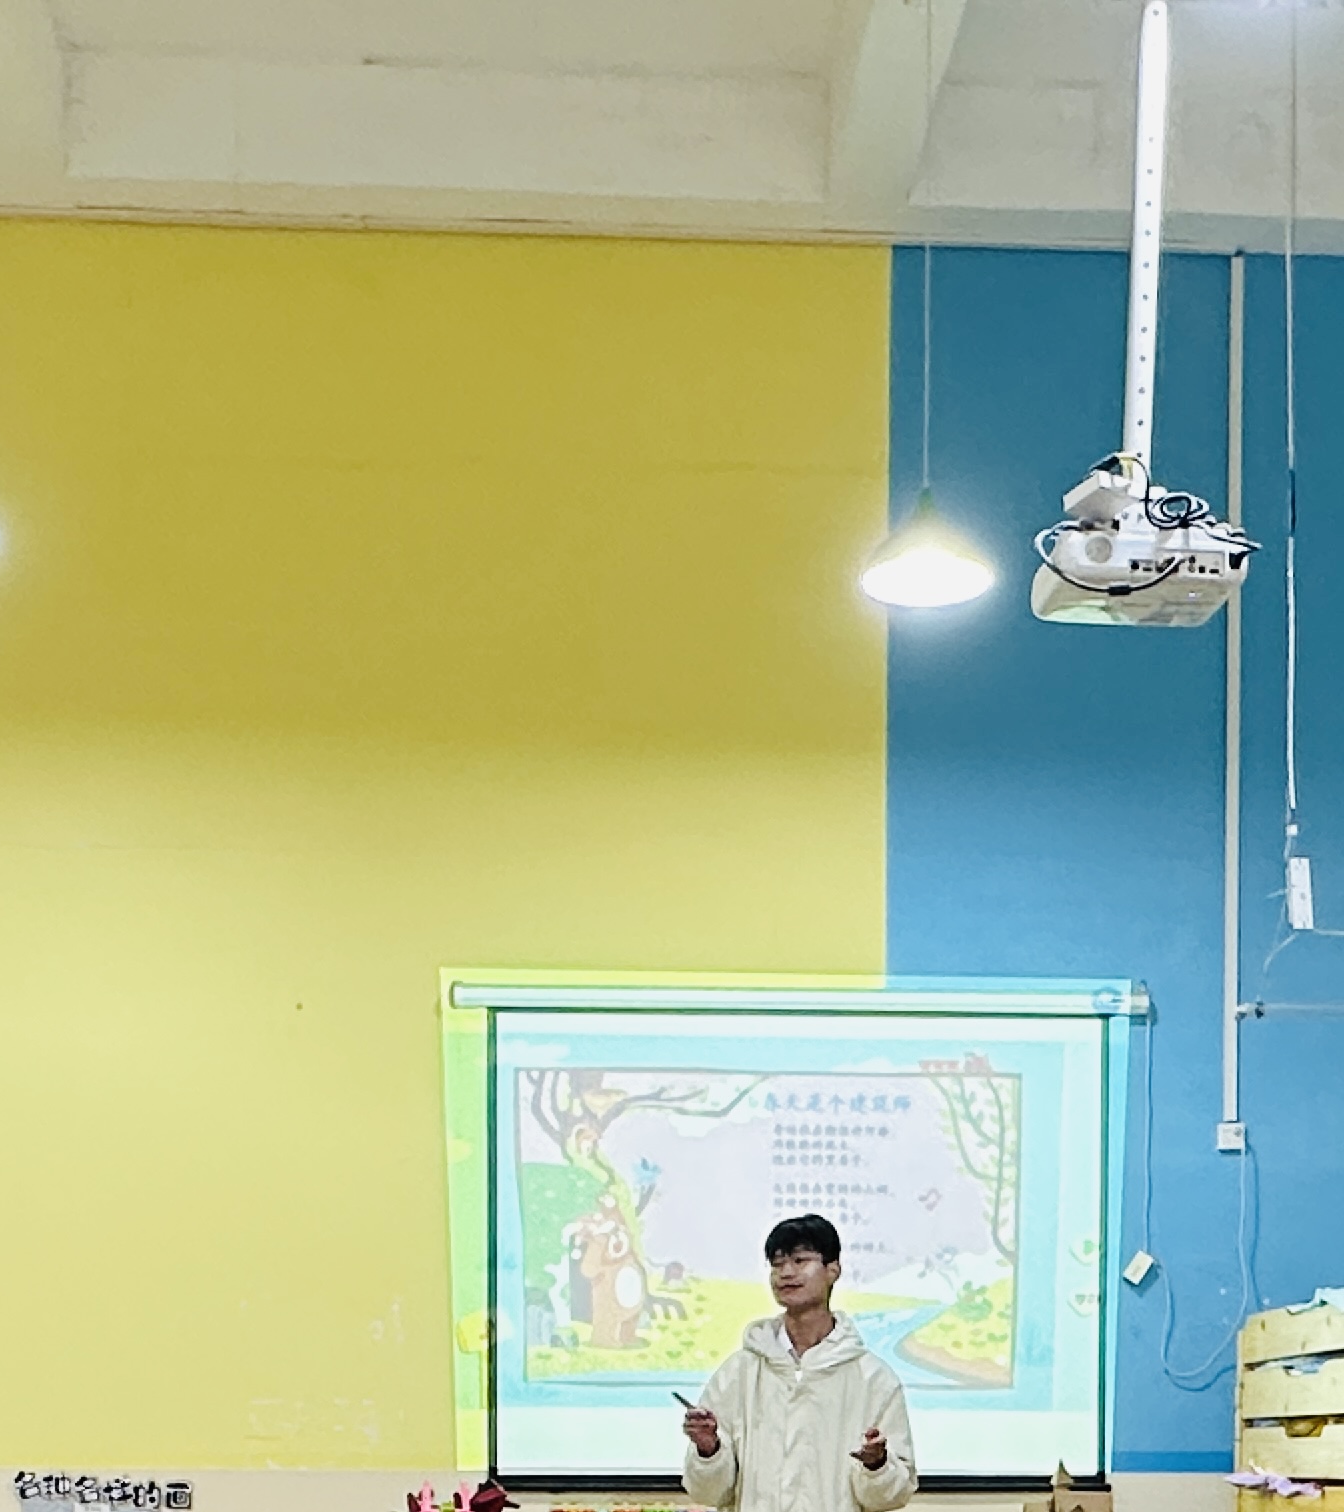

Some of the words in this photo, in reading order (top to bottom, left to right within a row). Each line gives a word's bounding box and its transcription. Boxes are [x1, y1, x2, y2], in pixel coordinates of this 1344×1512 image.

[14, 1471, 193, 1509] 各种各样的画
